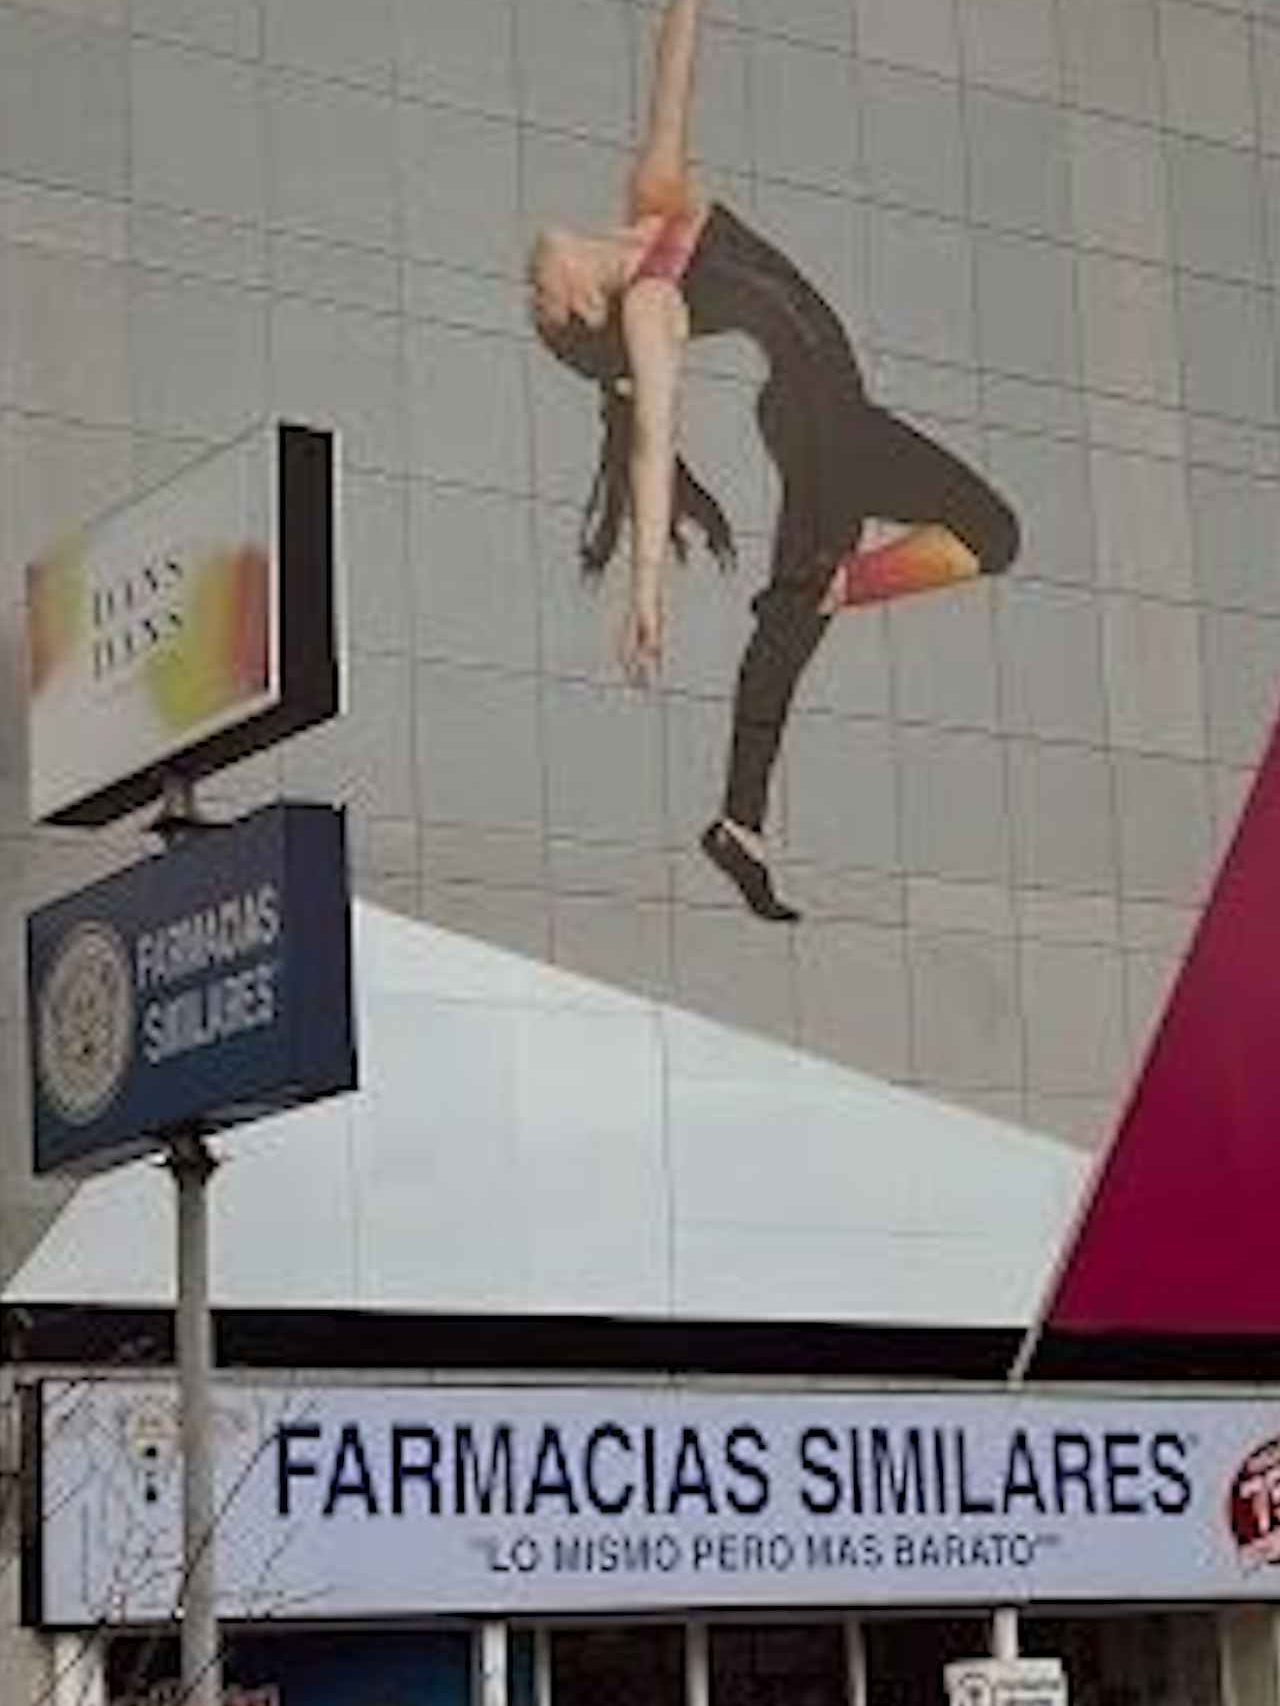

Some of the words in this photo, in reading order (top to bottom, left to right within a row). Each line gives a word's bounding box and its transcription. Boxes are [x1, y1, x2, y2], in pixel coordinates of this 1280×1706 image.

[135, 883, 281, 991] FARMACIAS
[143, 963, 276, 1064] SIMILARES
[274, 1423, 770, 1517] FARMACIAS
[799, 1425, 1194, 1516] SIMILARES
[552, 1533, 683, 1573] MISMO
[692, 1533, 795, 1572] PERO
